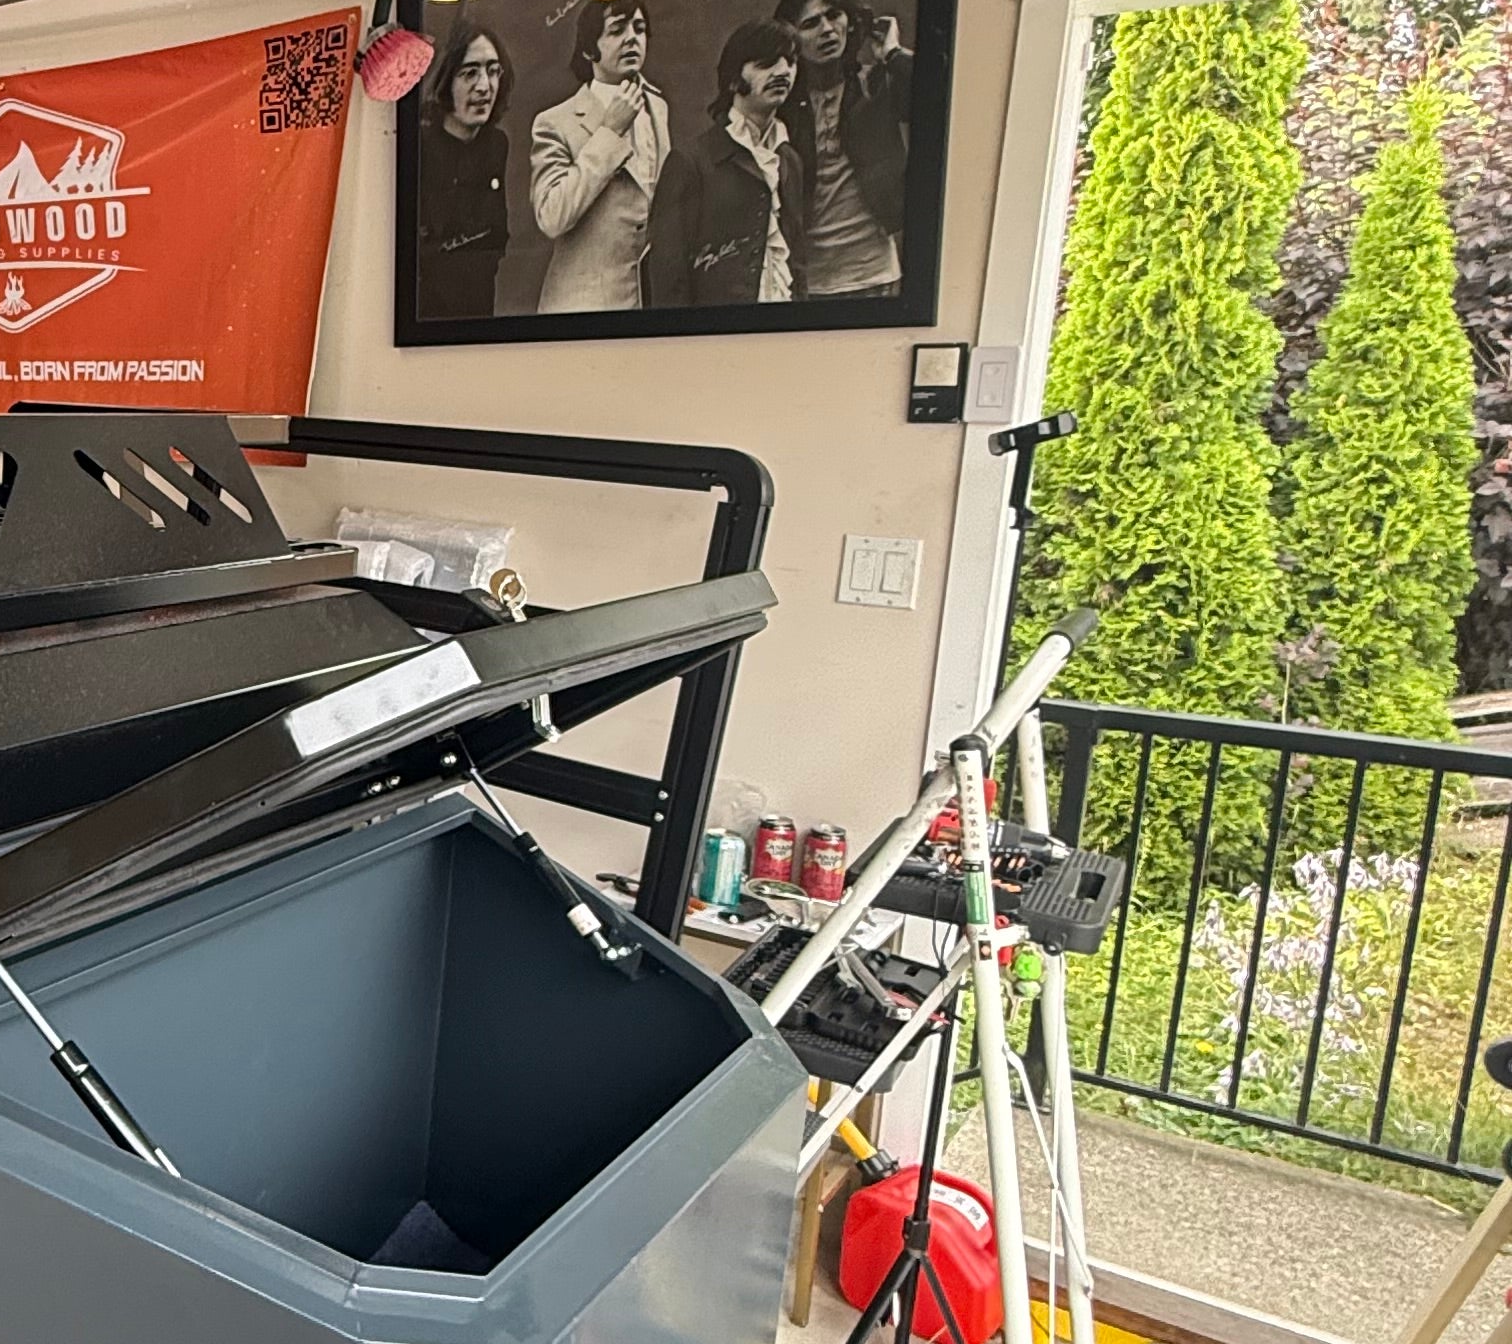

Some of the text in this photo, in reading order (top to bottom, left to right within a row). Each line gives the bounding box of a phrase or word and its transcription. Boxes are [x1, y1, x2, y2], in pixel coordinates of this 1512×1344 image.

[19, 247, 121, 262] SUPPLIES
[20, 360, 70, 382] BORN
[73, 360, 124, 382] FROM
[125, 359, 205, 382] PASSION
